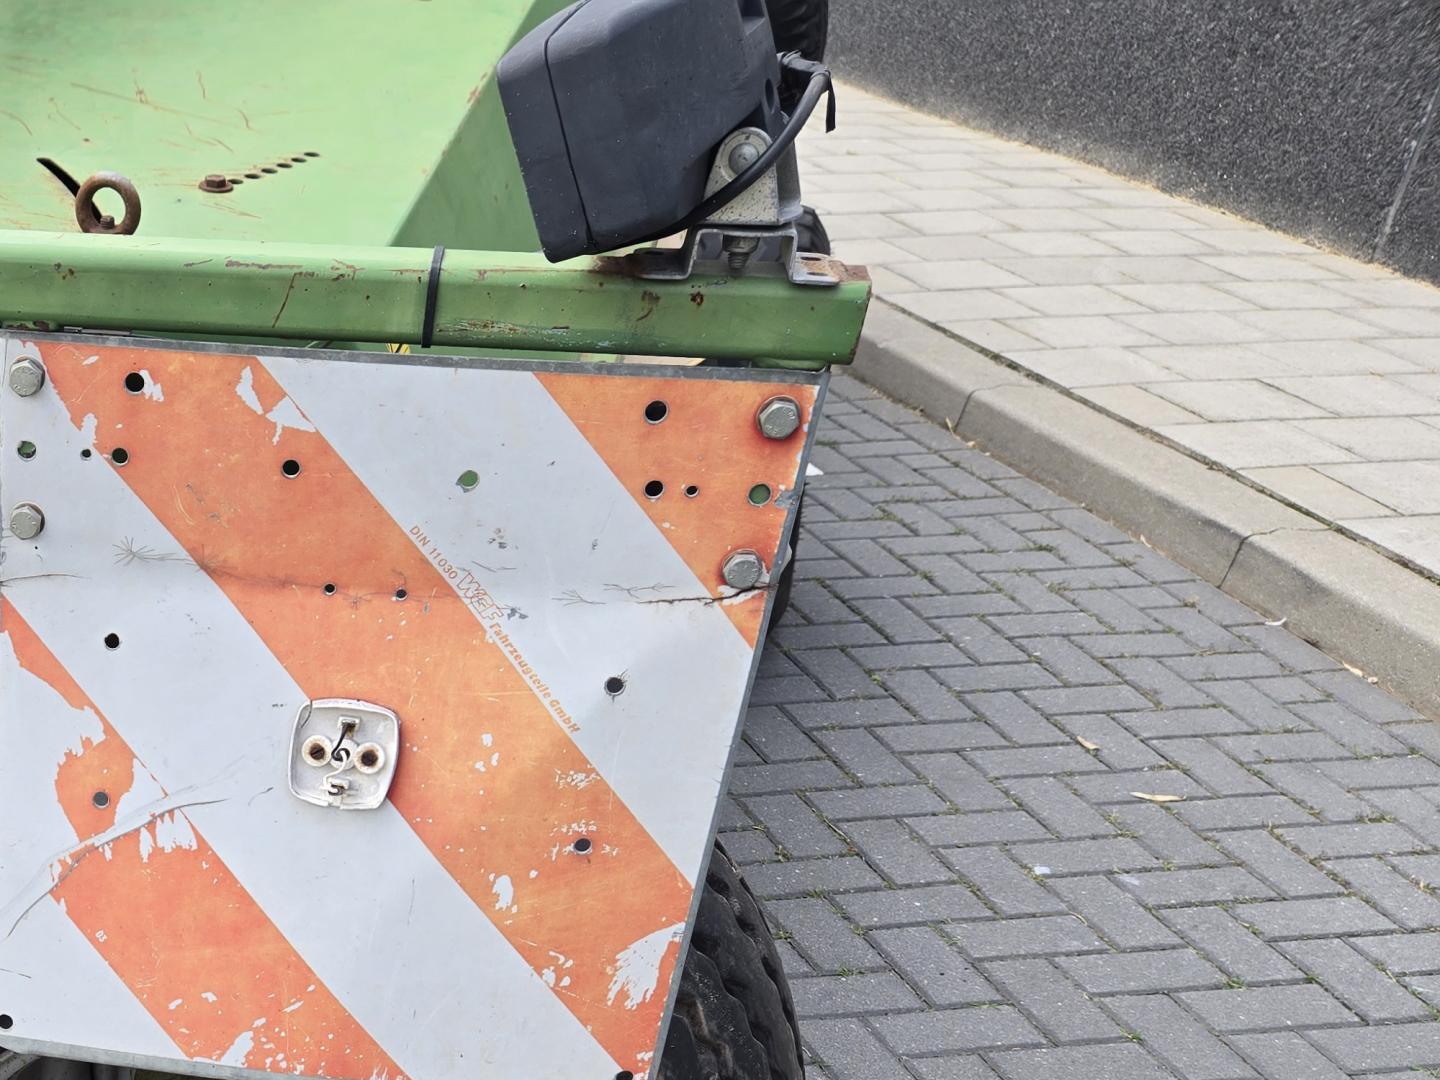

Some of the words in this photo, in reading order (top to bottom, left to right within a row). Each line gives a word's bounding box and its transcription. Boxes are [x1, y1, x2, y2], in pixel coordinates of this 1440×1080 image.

[409, 525, 431, 547] DIN
[429, 547, 458, 580] 11030
[549, 699, 581, 733] GmbH
